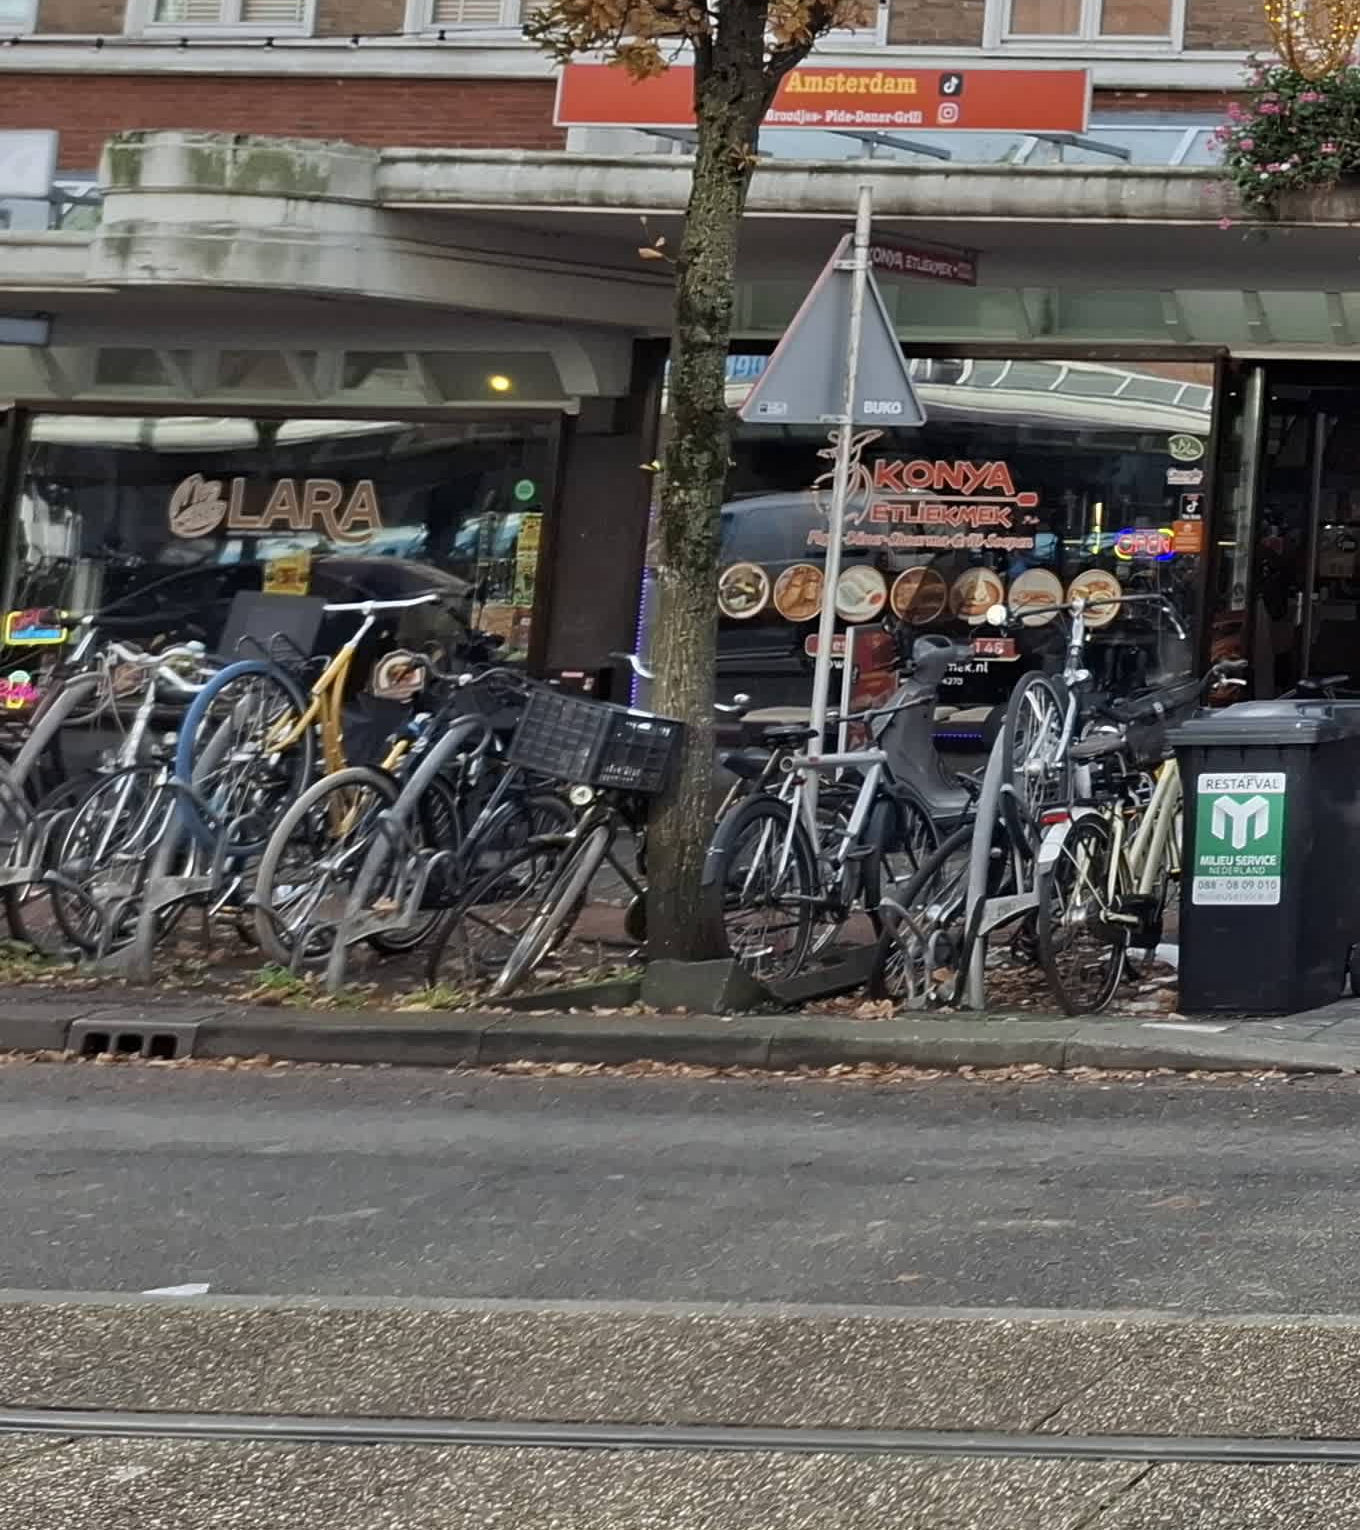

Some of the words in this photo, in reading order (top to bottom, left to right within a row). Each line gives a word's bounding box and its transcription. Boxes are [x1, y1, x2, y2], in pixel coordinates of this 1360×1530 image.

[785, 71, 917, 94] Amsterdam
[863, 401, 902, 415] BUKO
[875, 459, 1015, 495] KONYA
[226, 478, 382, 544] LARA
[1206, 778, 1279, 789] RESTAFVAL
[1199, 855, 1233, 866] MILIEU
[1235, 855, 1278, 866] SERVICE
[1208, 866, 1265, 875] NEDERLAND
